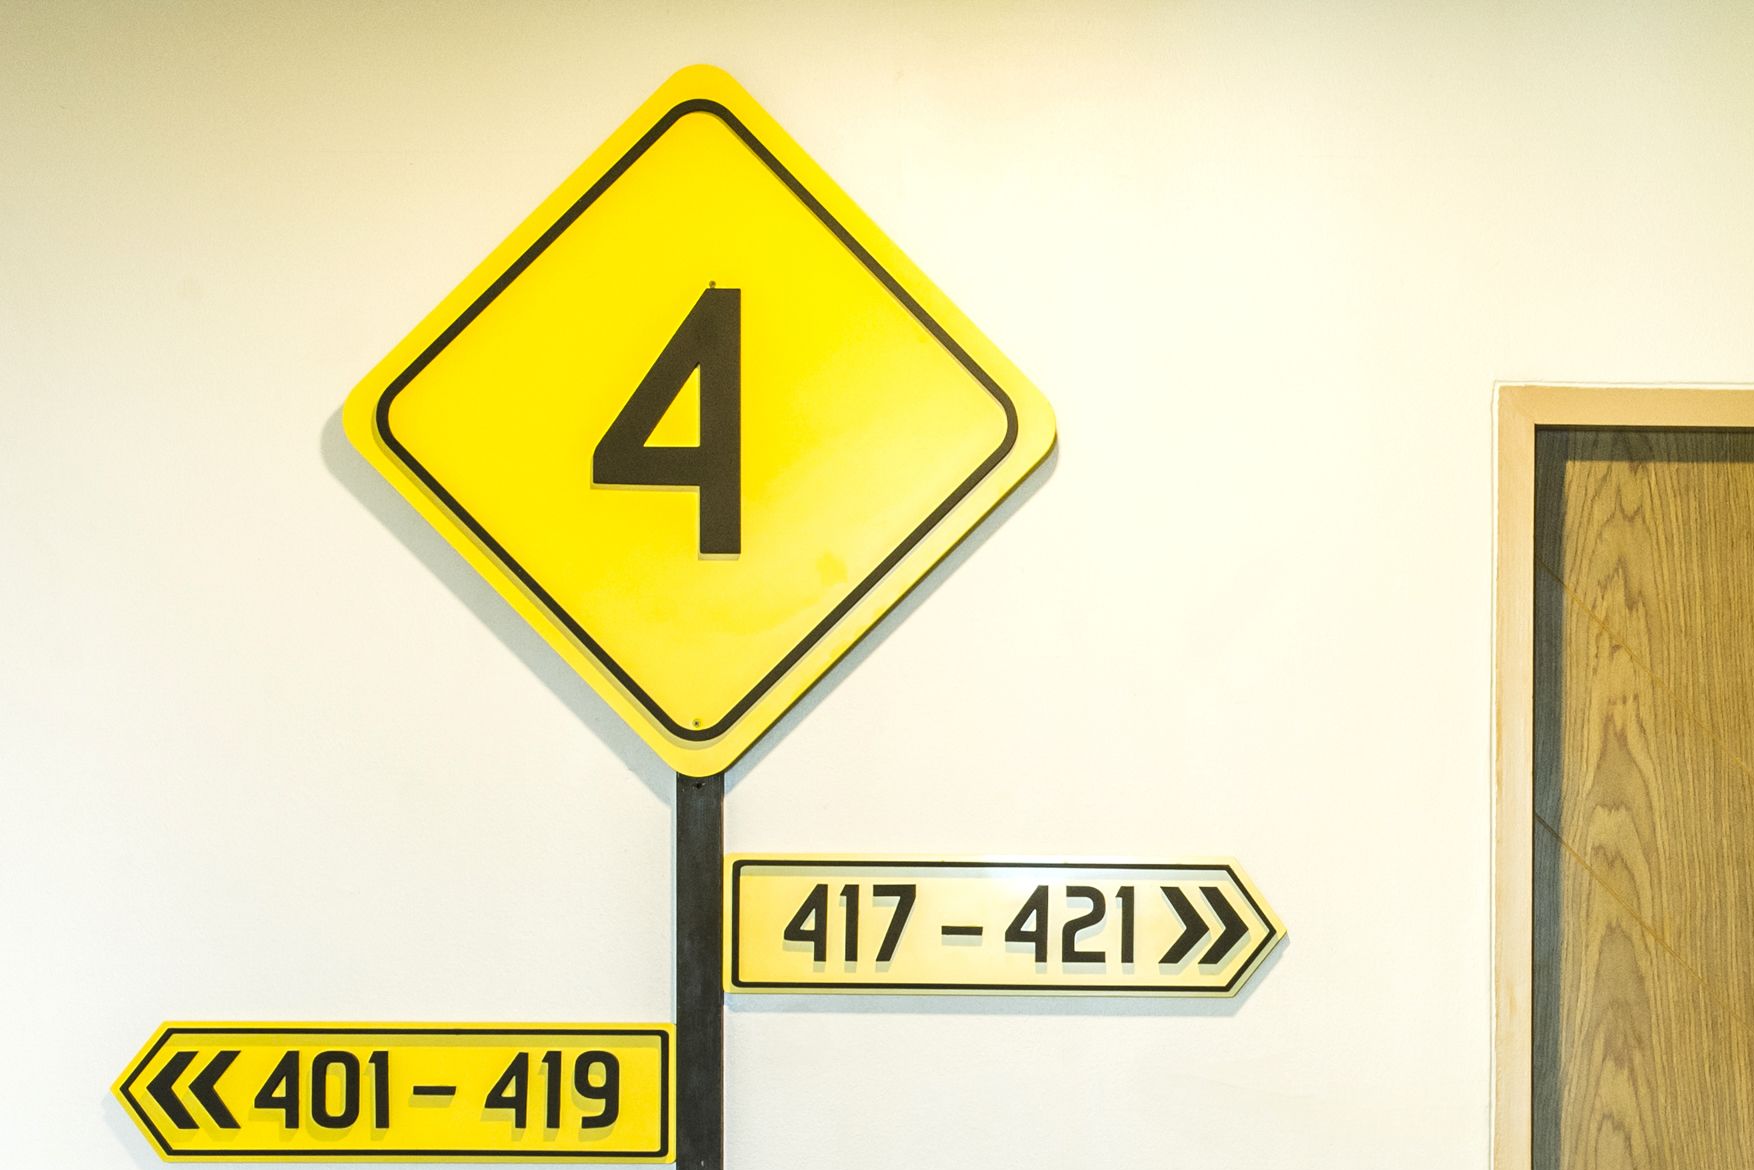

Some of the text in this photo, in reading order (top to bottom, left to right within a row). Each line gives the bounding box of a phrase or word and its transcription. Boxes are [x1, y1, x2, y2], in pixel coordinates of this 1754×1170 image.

[591, 286, 742, 555] 4
[782, 883, 917, 963] 417
[1003, 884, 1136, 965] 421
[253, 1049, 391, 1130] 401
[483, 1049, 621, 1130] 419
